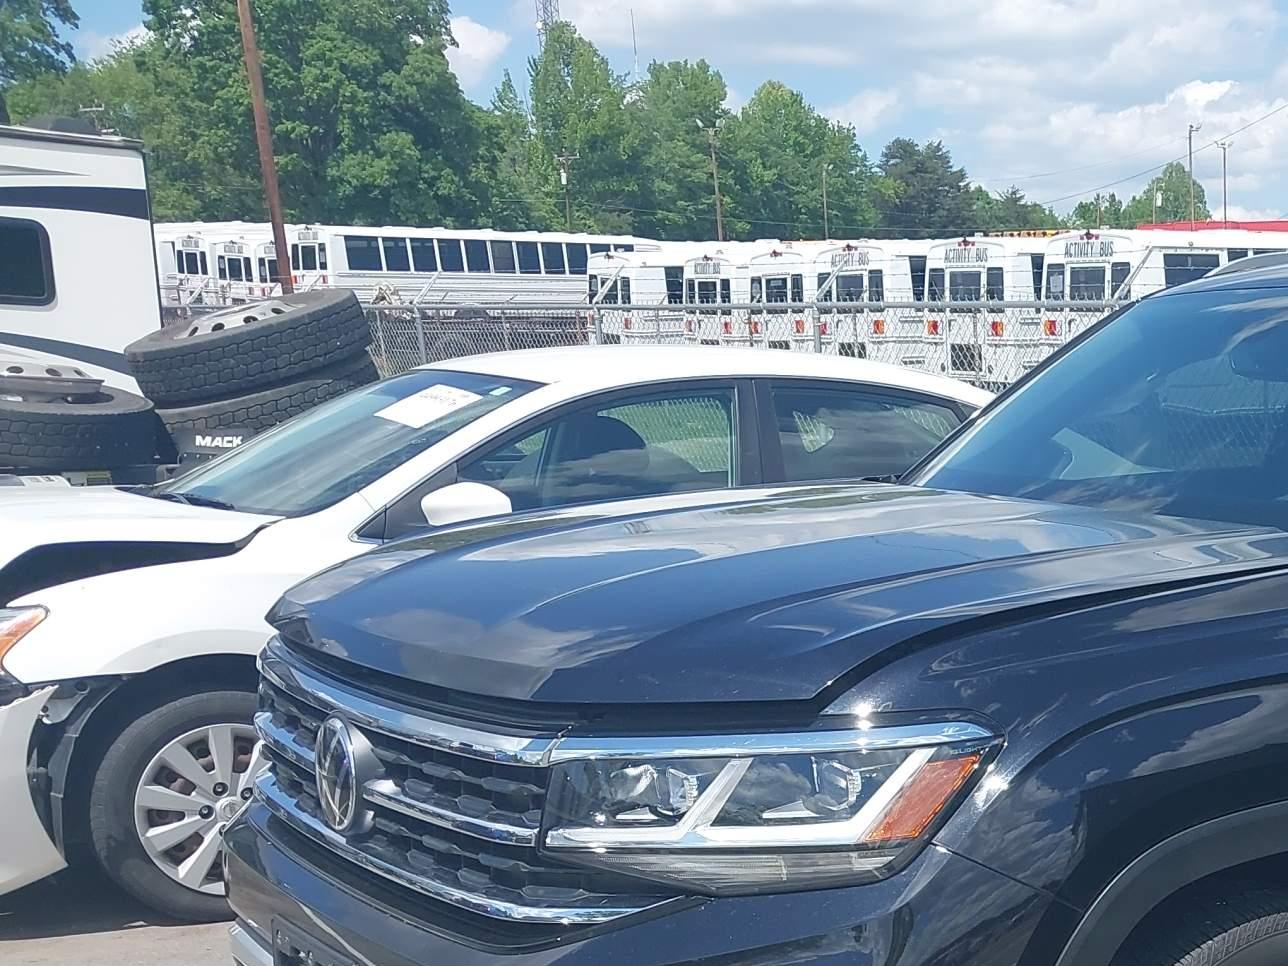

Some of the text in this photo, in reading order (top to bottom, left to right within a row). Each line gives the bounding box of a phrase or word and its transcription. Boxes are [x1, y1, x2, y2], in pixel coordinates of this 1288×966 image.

[944, 247, 988, 263] ACTIVITY BUS
[1064, 240, 1114, 258] ACTIVITY BUS
[831, 251, 870, 268] ACTIVITY BUS
[195, 435, 243, 448] MACK
